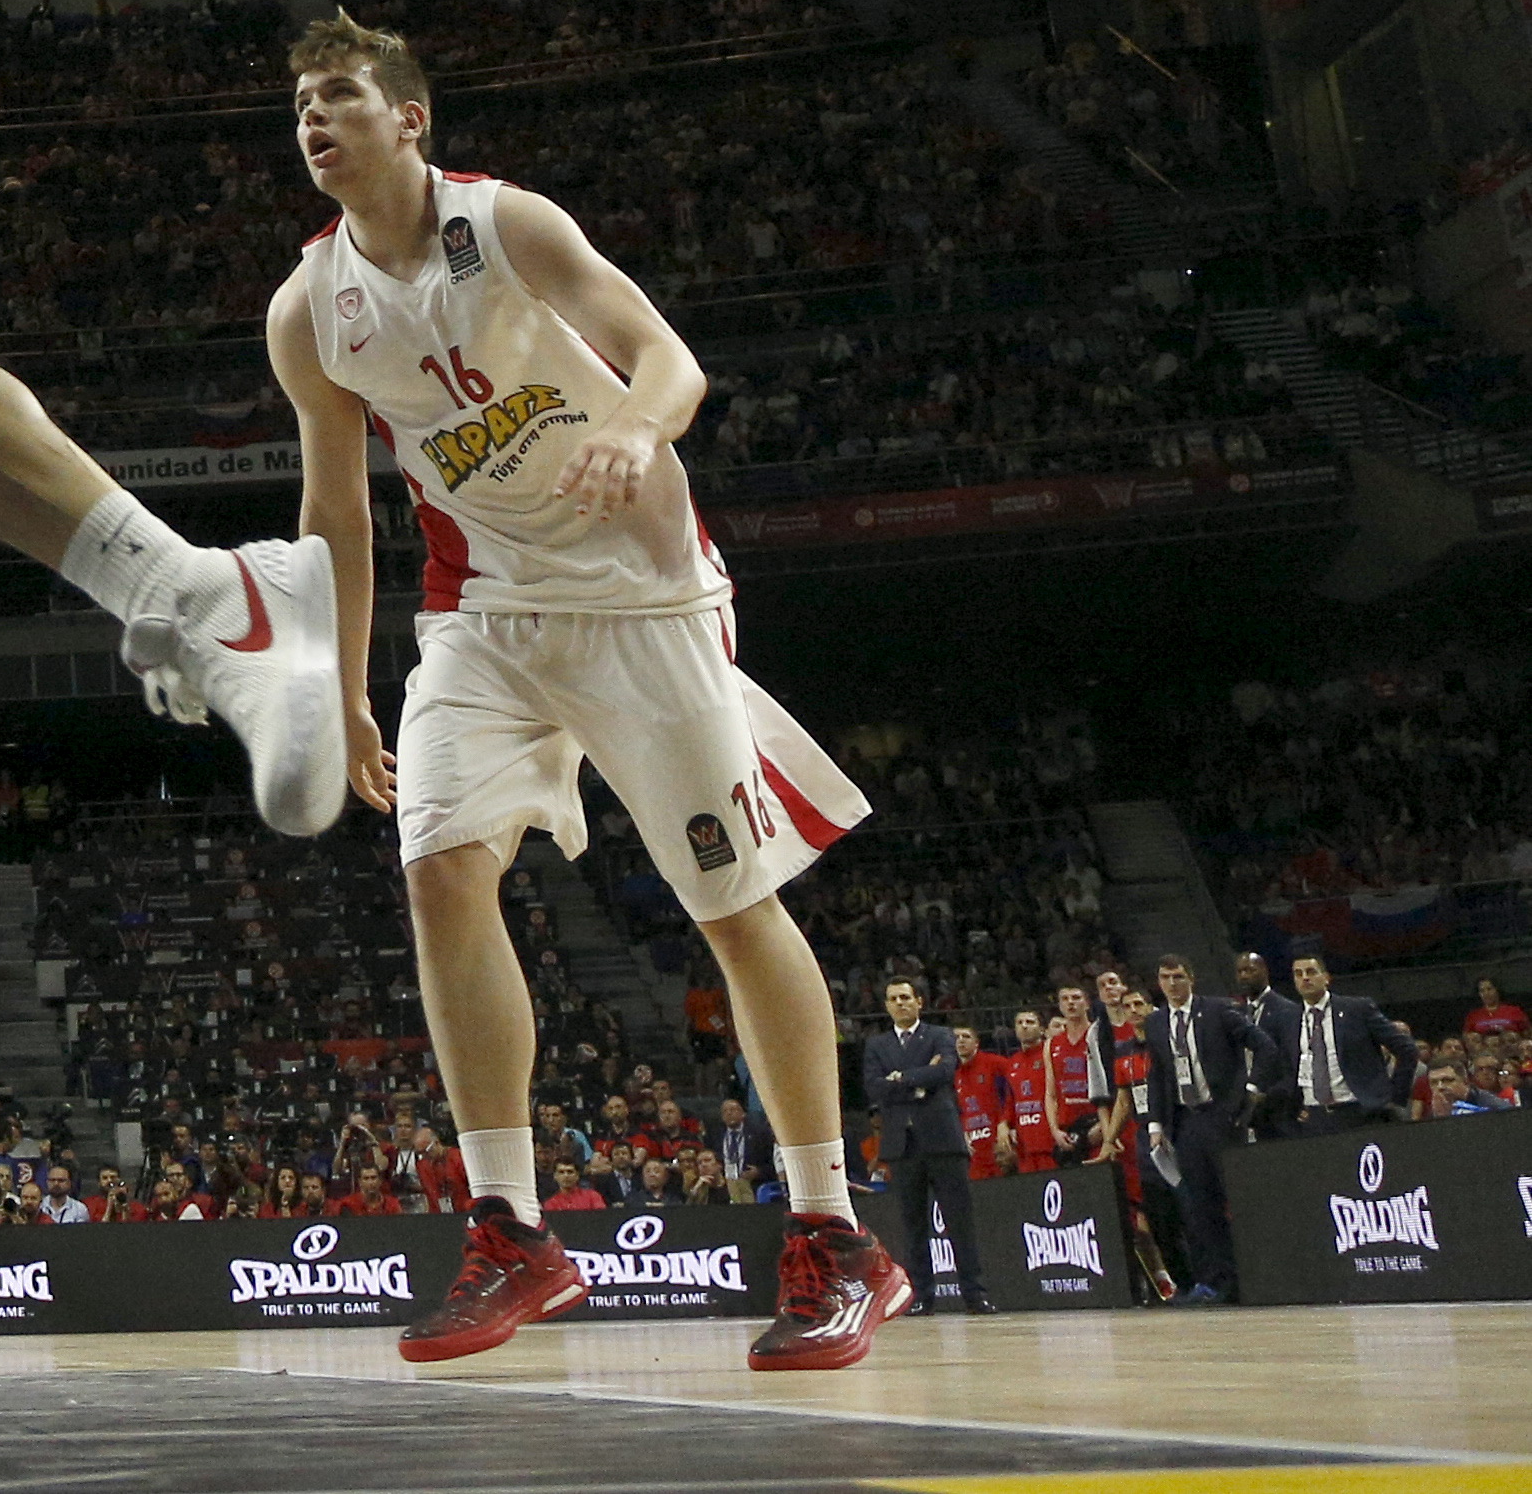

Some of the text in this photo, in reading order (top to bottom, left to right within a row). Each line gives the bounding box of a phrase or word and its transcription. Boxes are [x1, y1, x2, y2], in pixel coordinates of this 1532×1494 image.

[419, 345, 494, 409] 16
[110, 456, 208, 480] unidad
[218, 454, 253, 473] de
[489, 454, 522, 483] Τύχη
[731, 770, 775, 849] 16
[1329, 1185, 1440, 1254] SPALDING
[1022, 1217, 1104, 1276] SPALDING
[229, 1253, 414, 1303] SPALDING
[588, 1293, 708, 1307] TRUE TO THE GAME
[261, 1302, 381, 1316] TRUE TO THE GAME
